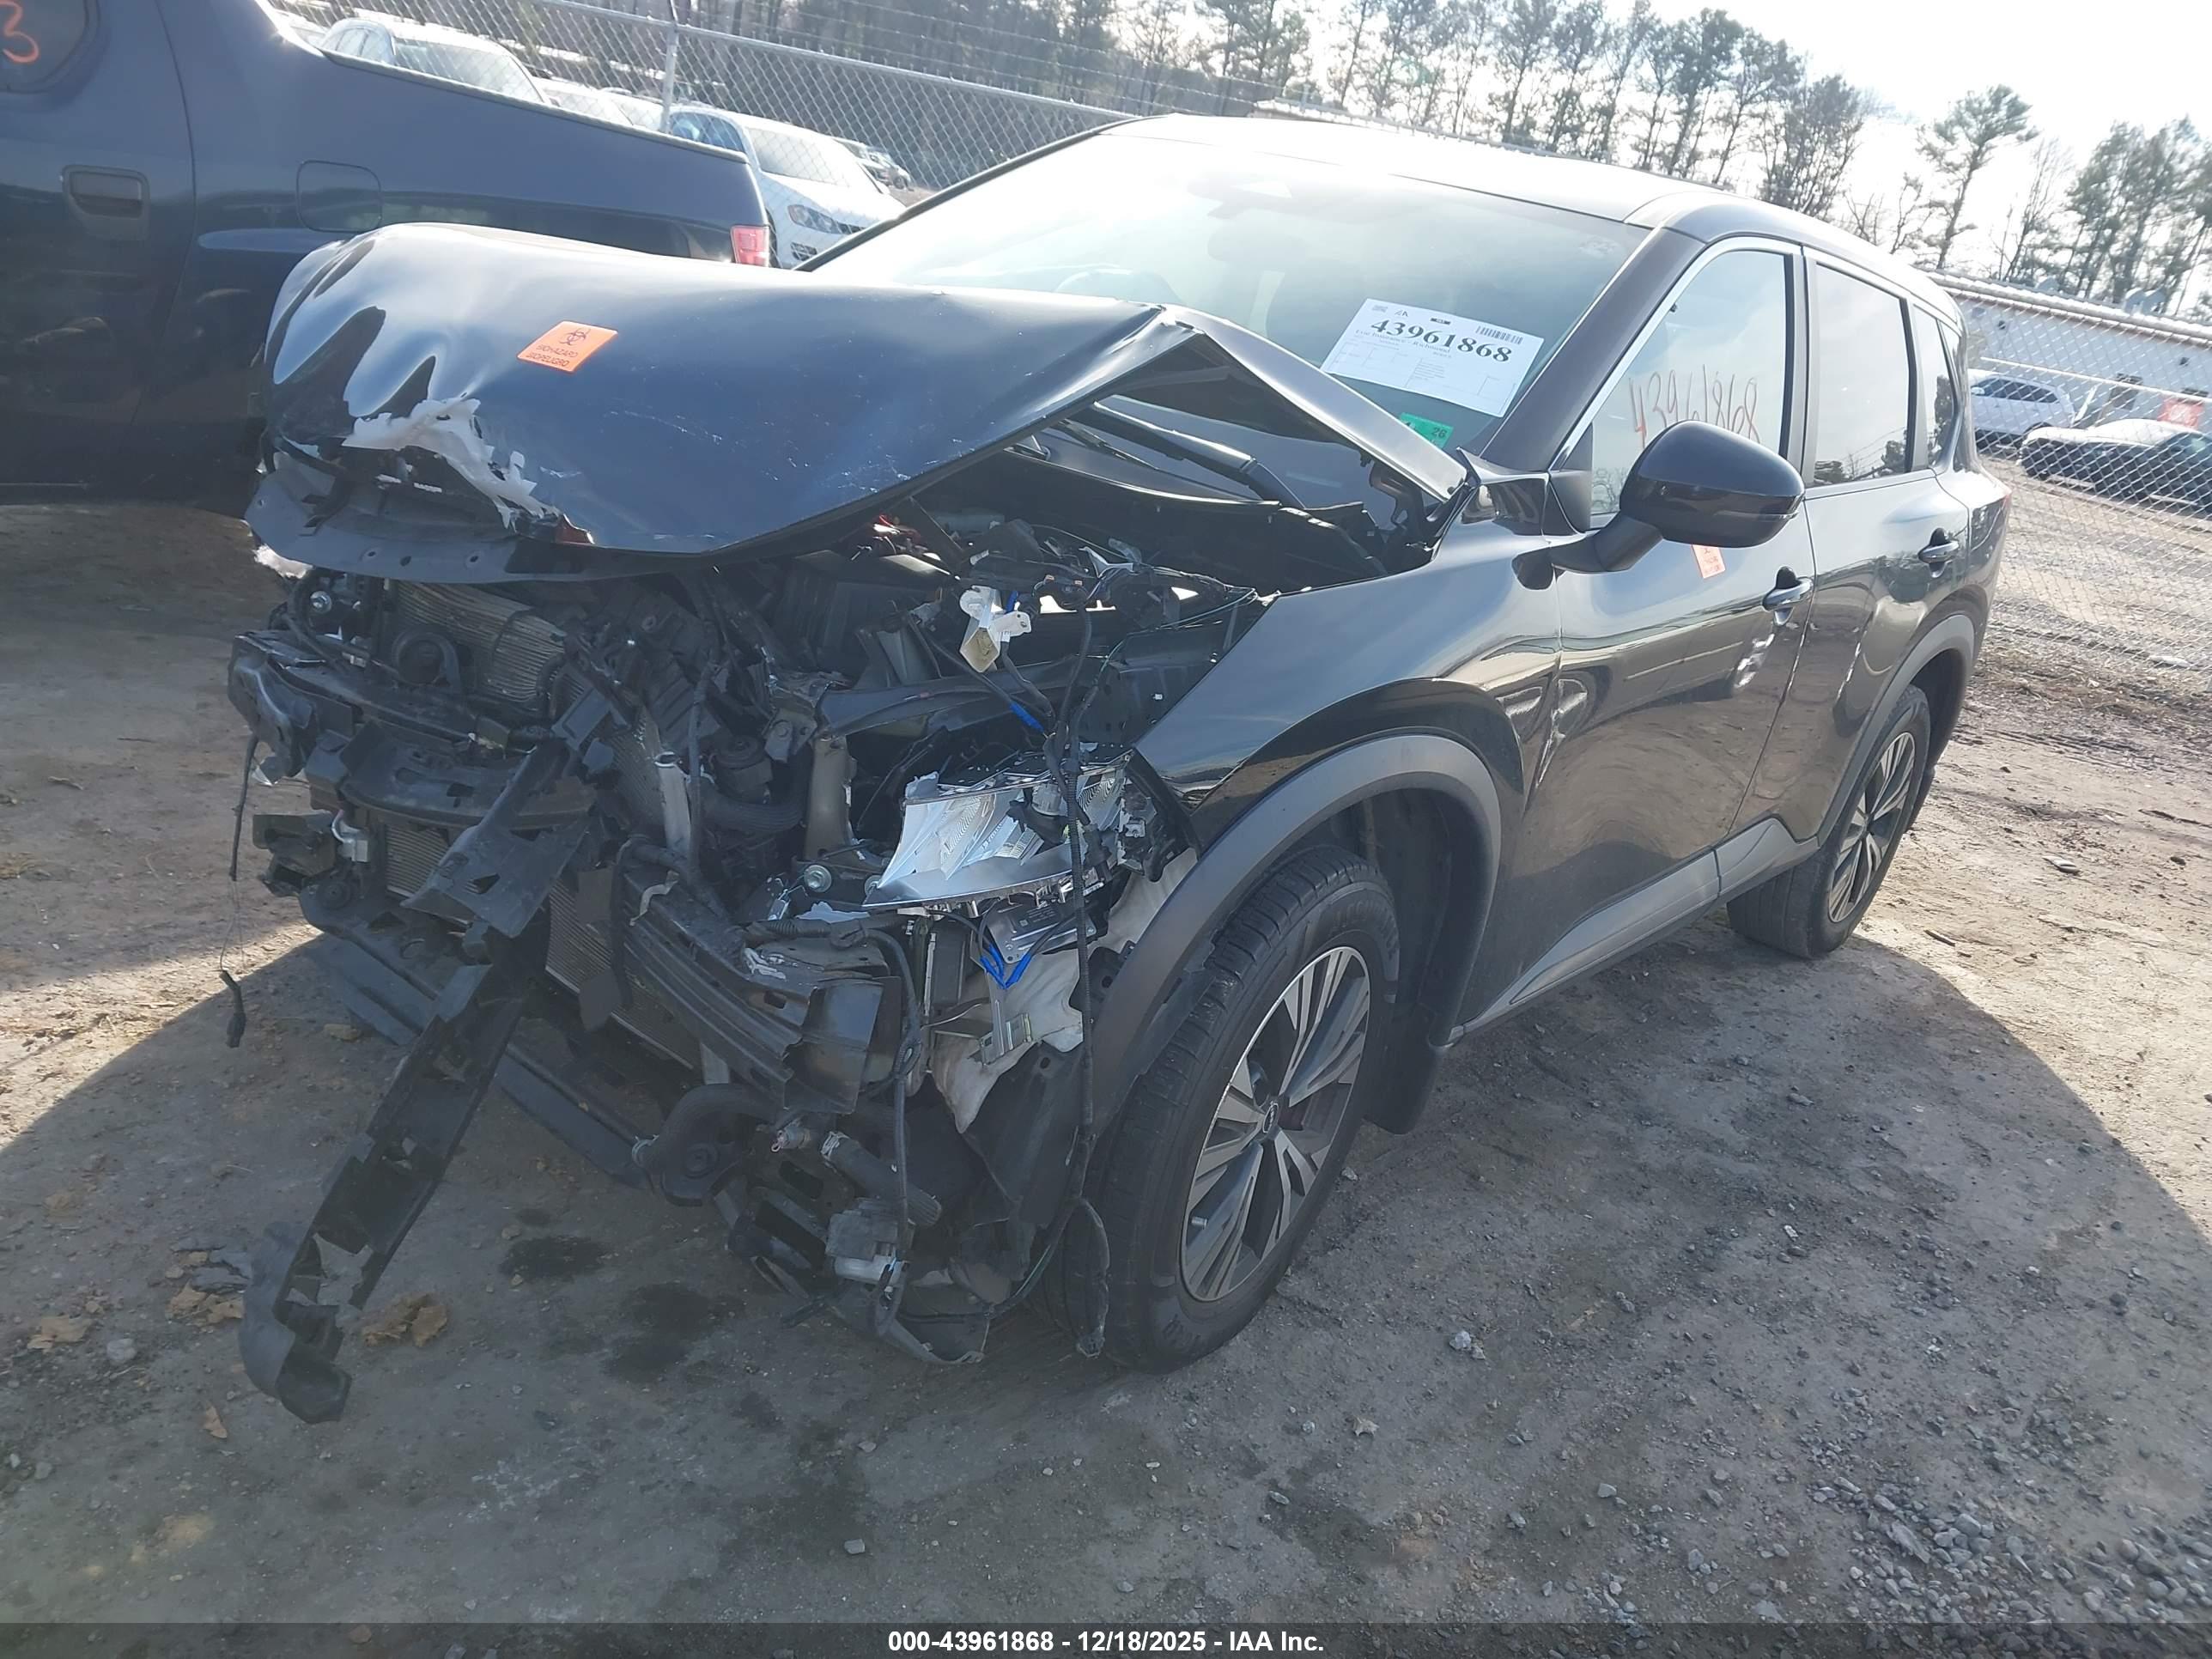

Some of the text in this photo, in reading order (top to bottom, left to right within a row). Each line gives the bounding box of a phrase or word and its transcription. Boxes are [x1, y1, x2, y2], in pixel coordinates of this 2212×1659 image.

[1370, 319, 1513, 362] 43961868
[535, 343, 580, 358] BIOHAZARD
[525, 352, 570, 367] BIOPELIGRO
